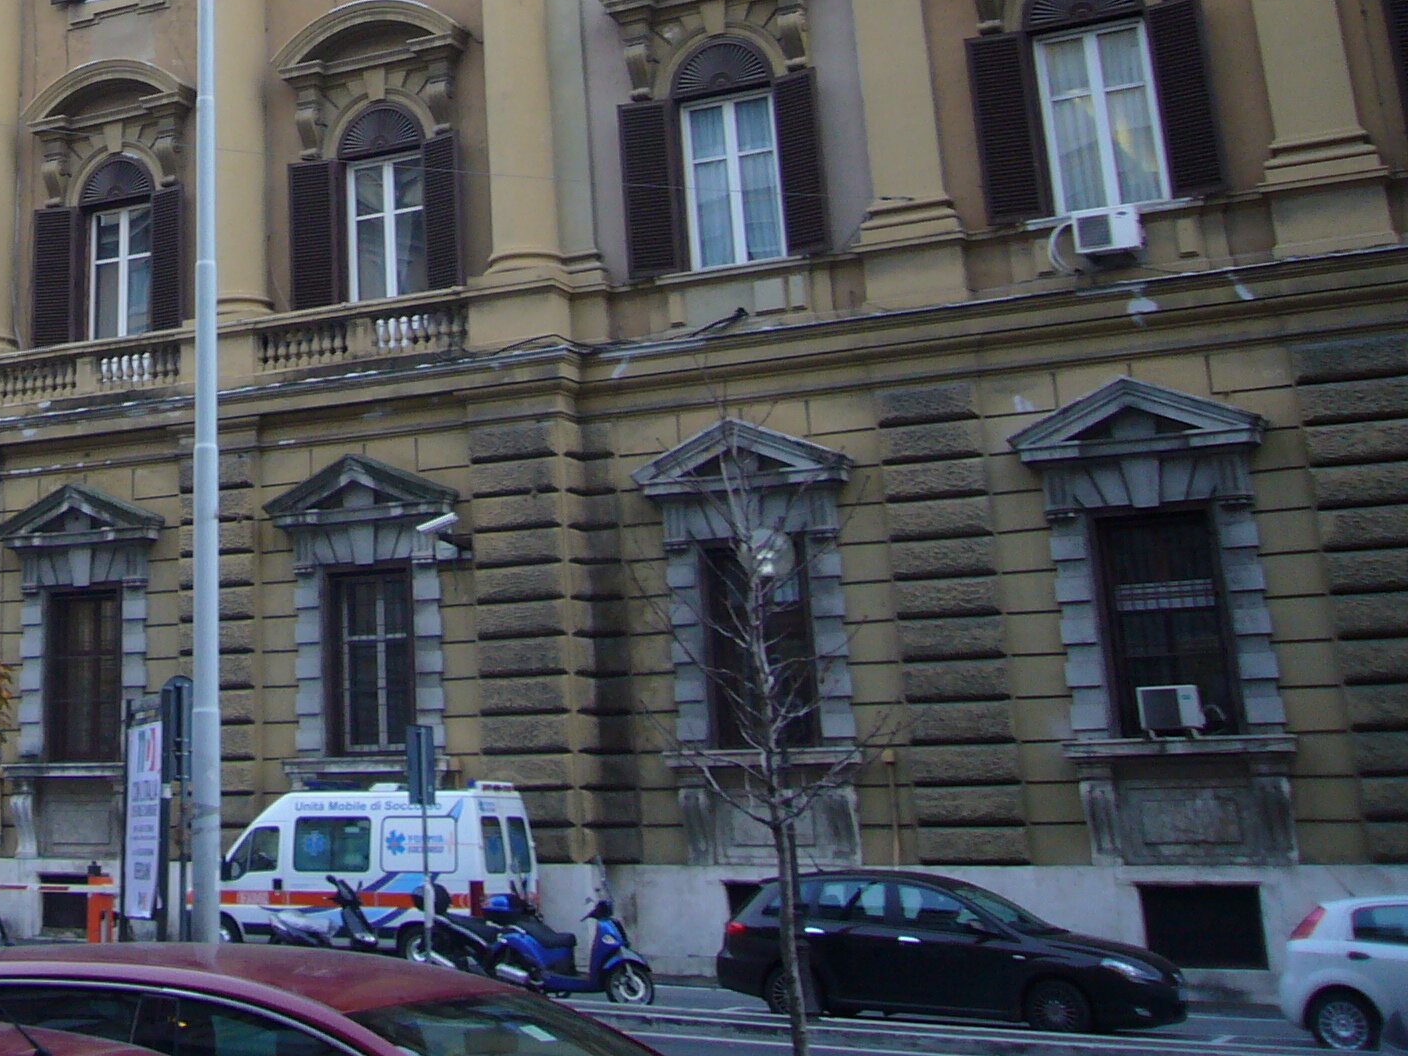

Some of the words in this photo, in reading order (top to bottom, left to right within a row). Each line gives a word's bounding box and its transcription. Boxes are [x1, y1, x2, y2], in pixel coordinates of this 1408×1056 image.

[295, 800, 325, 812] Unità
[328, 800, 367, 812] Mobile
[370, 800, 381, 811] di
